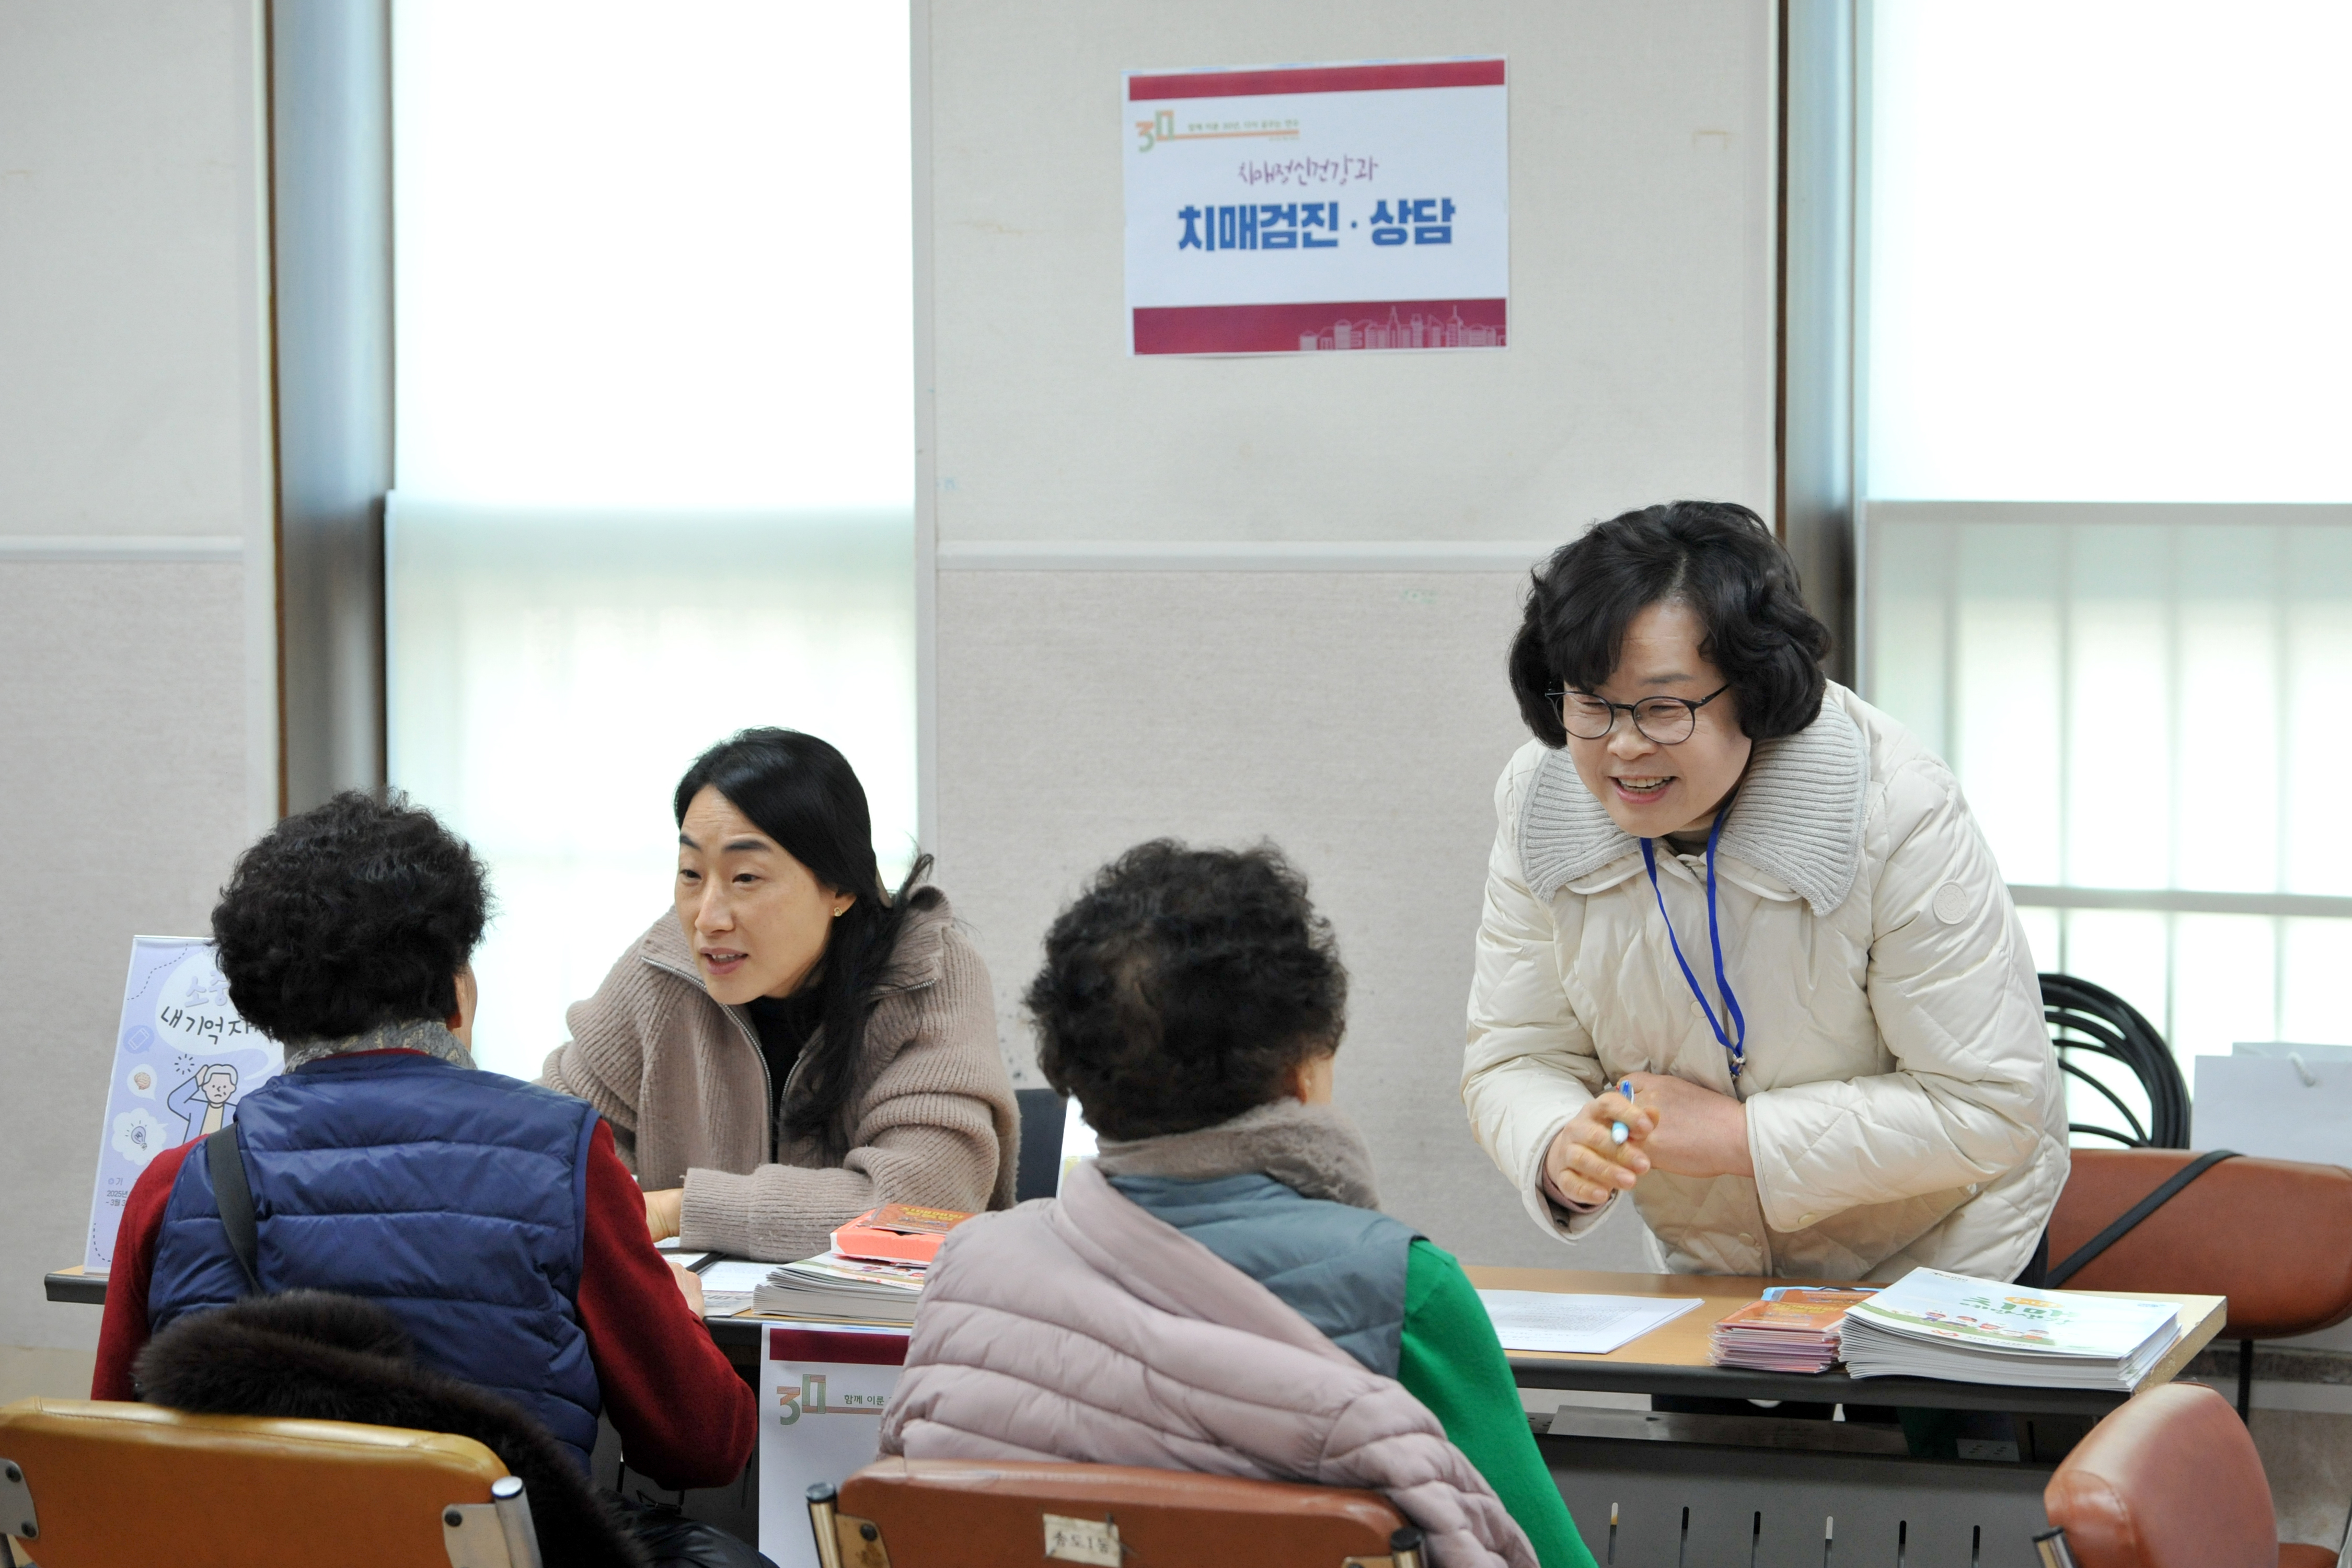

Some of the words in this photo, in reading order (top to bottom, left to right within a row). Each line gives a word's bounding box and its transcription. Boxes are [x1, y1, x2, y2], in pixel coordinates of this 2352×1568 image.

[107, 1190, 129, 1198] 2025년
[844, 1394, 863, 1405] 함께
[867, 1395, 885, 1406] 이룬
